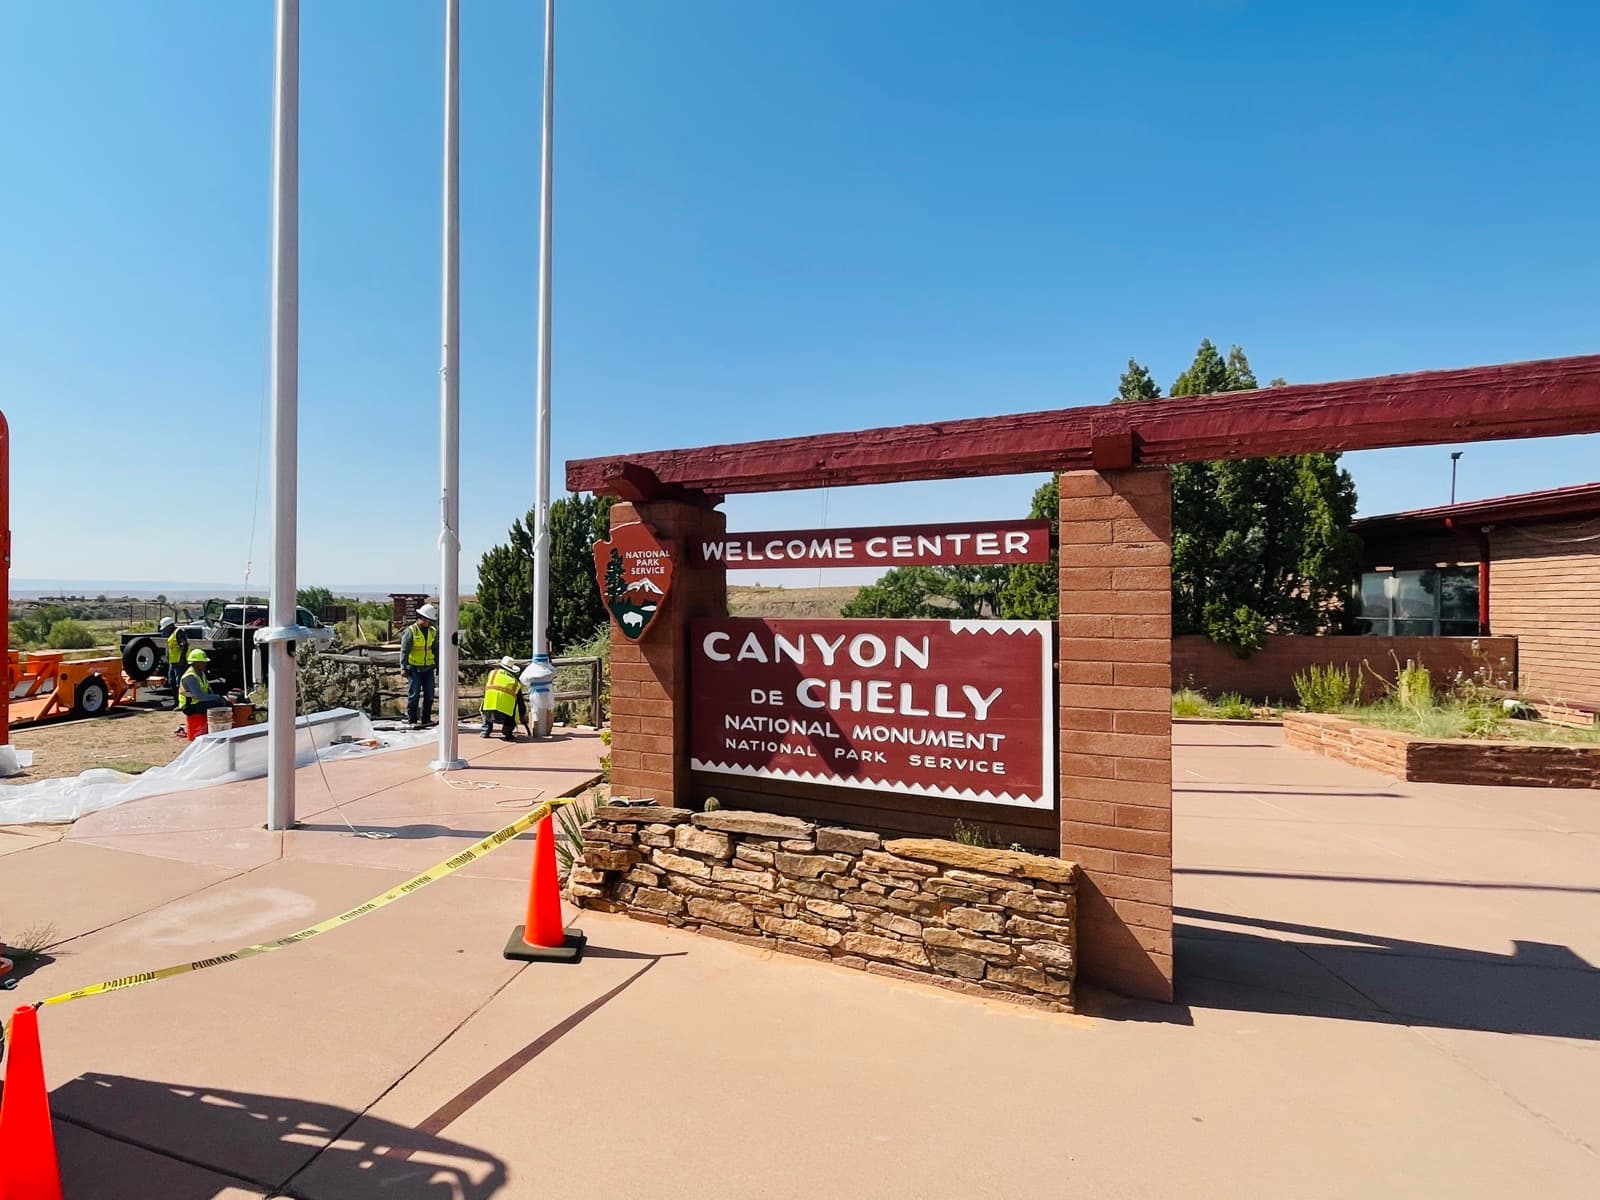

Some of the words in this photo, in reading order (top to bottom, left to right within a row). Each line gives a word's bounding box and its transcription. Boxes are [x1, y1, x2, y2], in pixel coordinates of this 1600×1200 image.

[625, 549, 671, 559] NATIONAL
[636, 558, 660, 567] PARK
[702, 538, 855, 561] WELCOME
[865, 531, 1030, 558] CENTER
[630, 566, 665, 575] SERVICE
[702, 631, 930, 670] CANYON
[750, 688, 784, 706] DE
[795, 677, 1003, 721] CHELLY
[725, 714, 840, 738] NATIONAL
[852, 724, 1006, 752] MONUMENT
[726, 738, 817, 757] NATIONAL
[834, 747, 888, 764] PARK
[909, 754, 1006, 775] SERVICE
